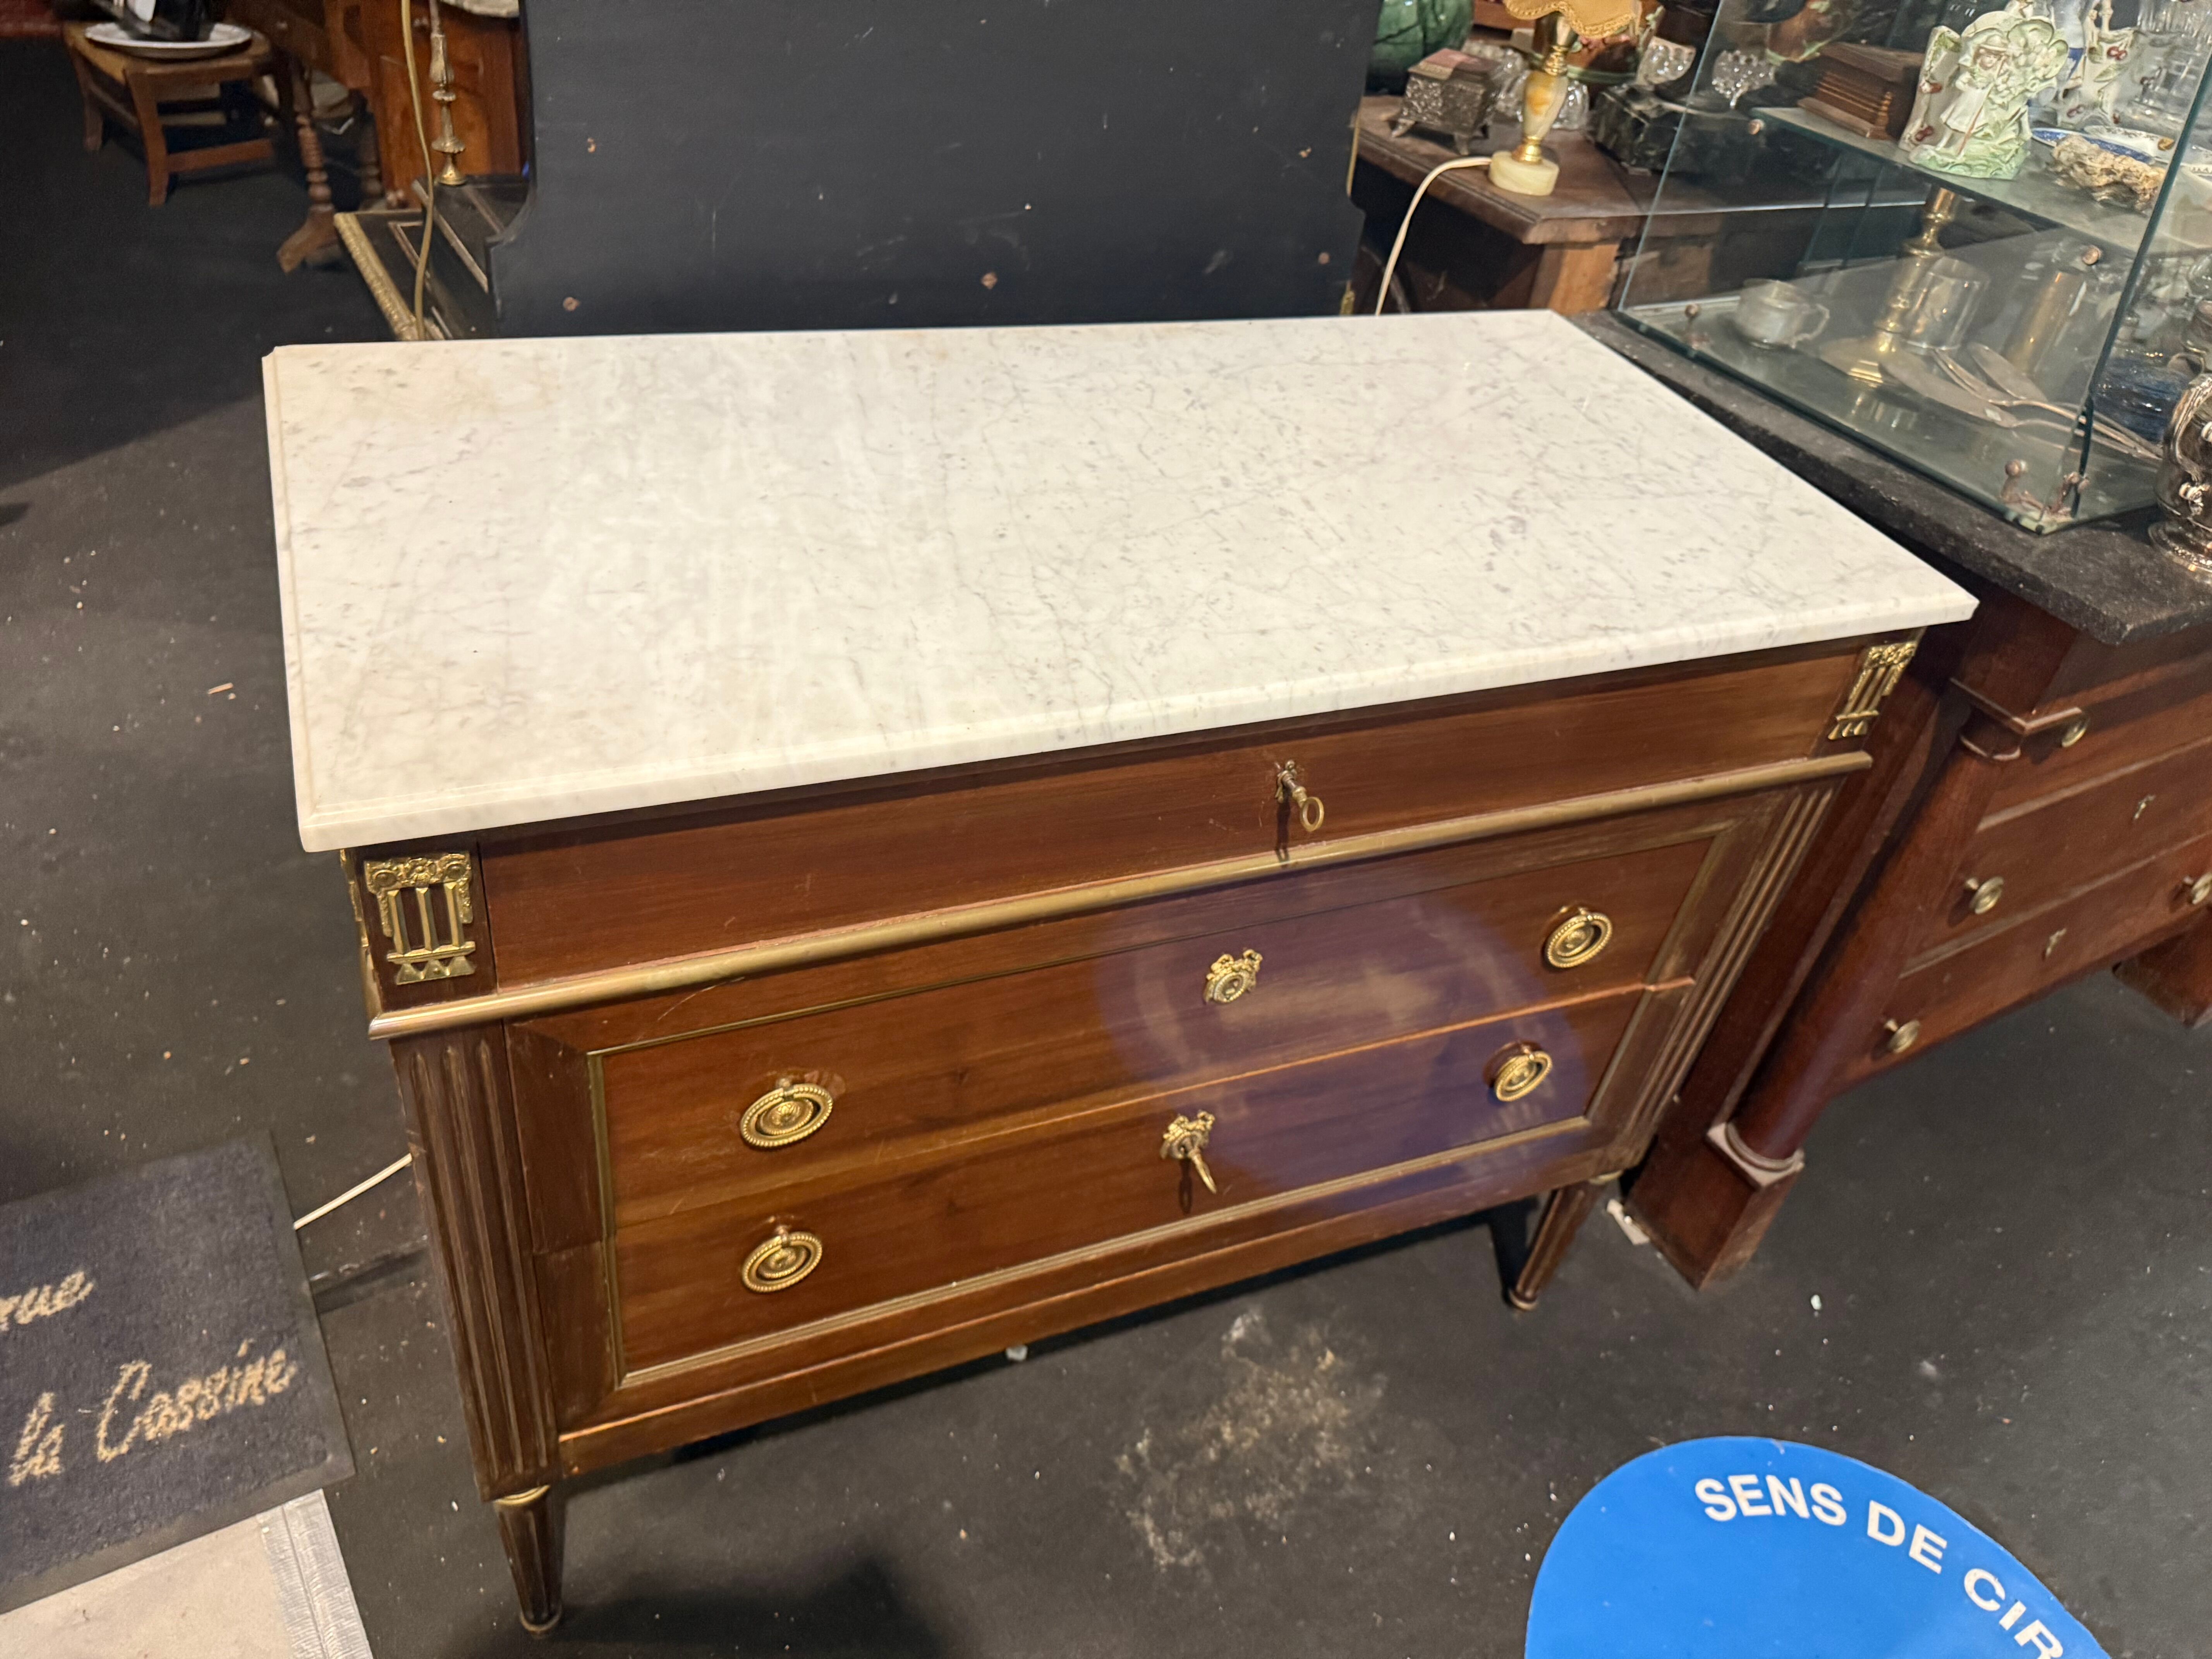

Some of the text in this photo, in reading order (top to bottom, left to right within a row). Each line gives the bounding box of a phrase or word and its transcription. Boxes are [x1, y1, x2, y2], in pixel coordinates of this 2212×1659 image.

[1695, 1474, 2064, 1659] SENS DE CIR
